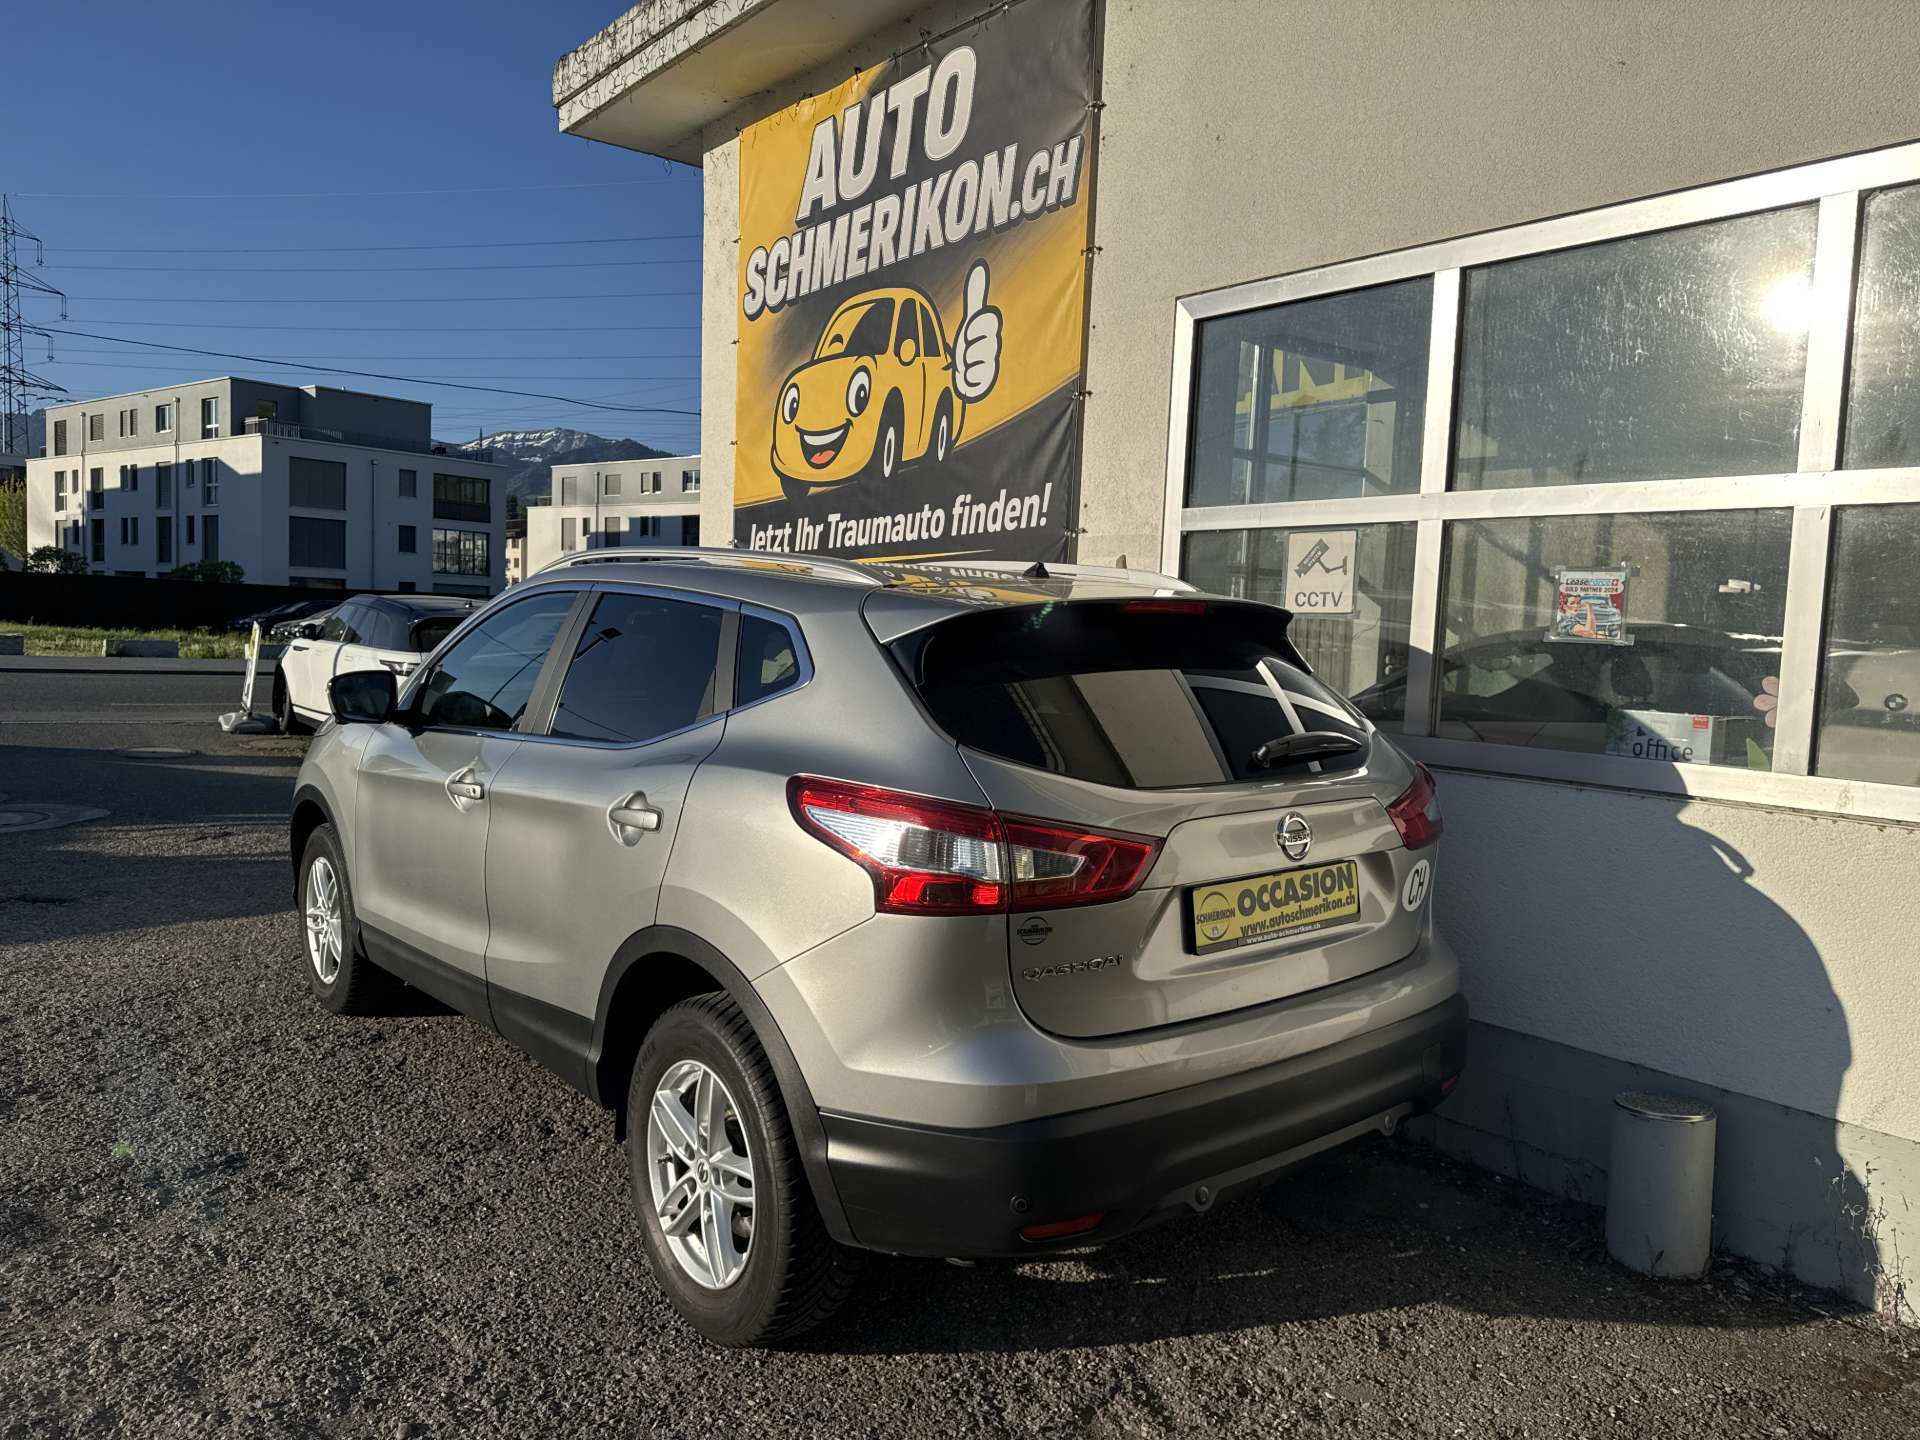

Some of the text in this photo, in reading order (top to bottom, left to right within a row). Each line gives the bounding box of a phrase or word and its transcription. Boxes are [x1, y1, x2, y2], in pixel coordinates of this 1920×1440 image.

[796, 45, 977, 223] AUTO
[743, 134, 1085, 319] SCHMERIKON.CH
[750, 482, 1053, 552] Jetzt Ihr Traumauto finden!
[1294, 591, 1343, 607] CCTV
[1632, 738, 1694, 761] office
[1237, 862, 1355, 917] OCCASION
[1407, 867, 1426, 906] CH
[1239, 890, 1356, 937] www.autoschmerikon.ch
[1023, 954, 1124, 981] QASHQAI
